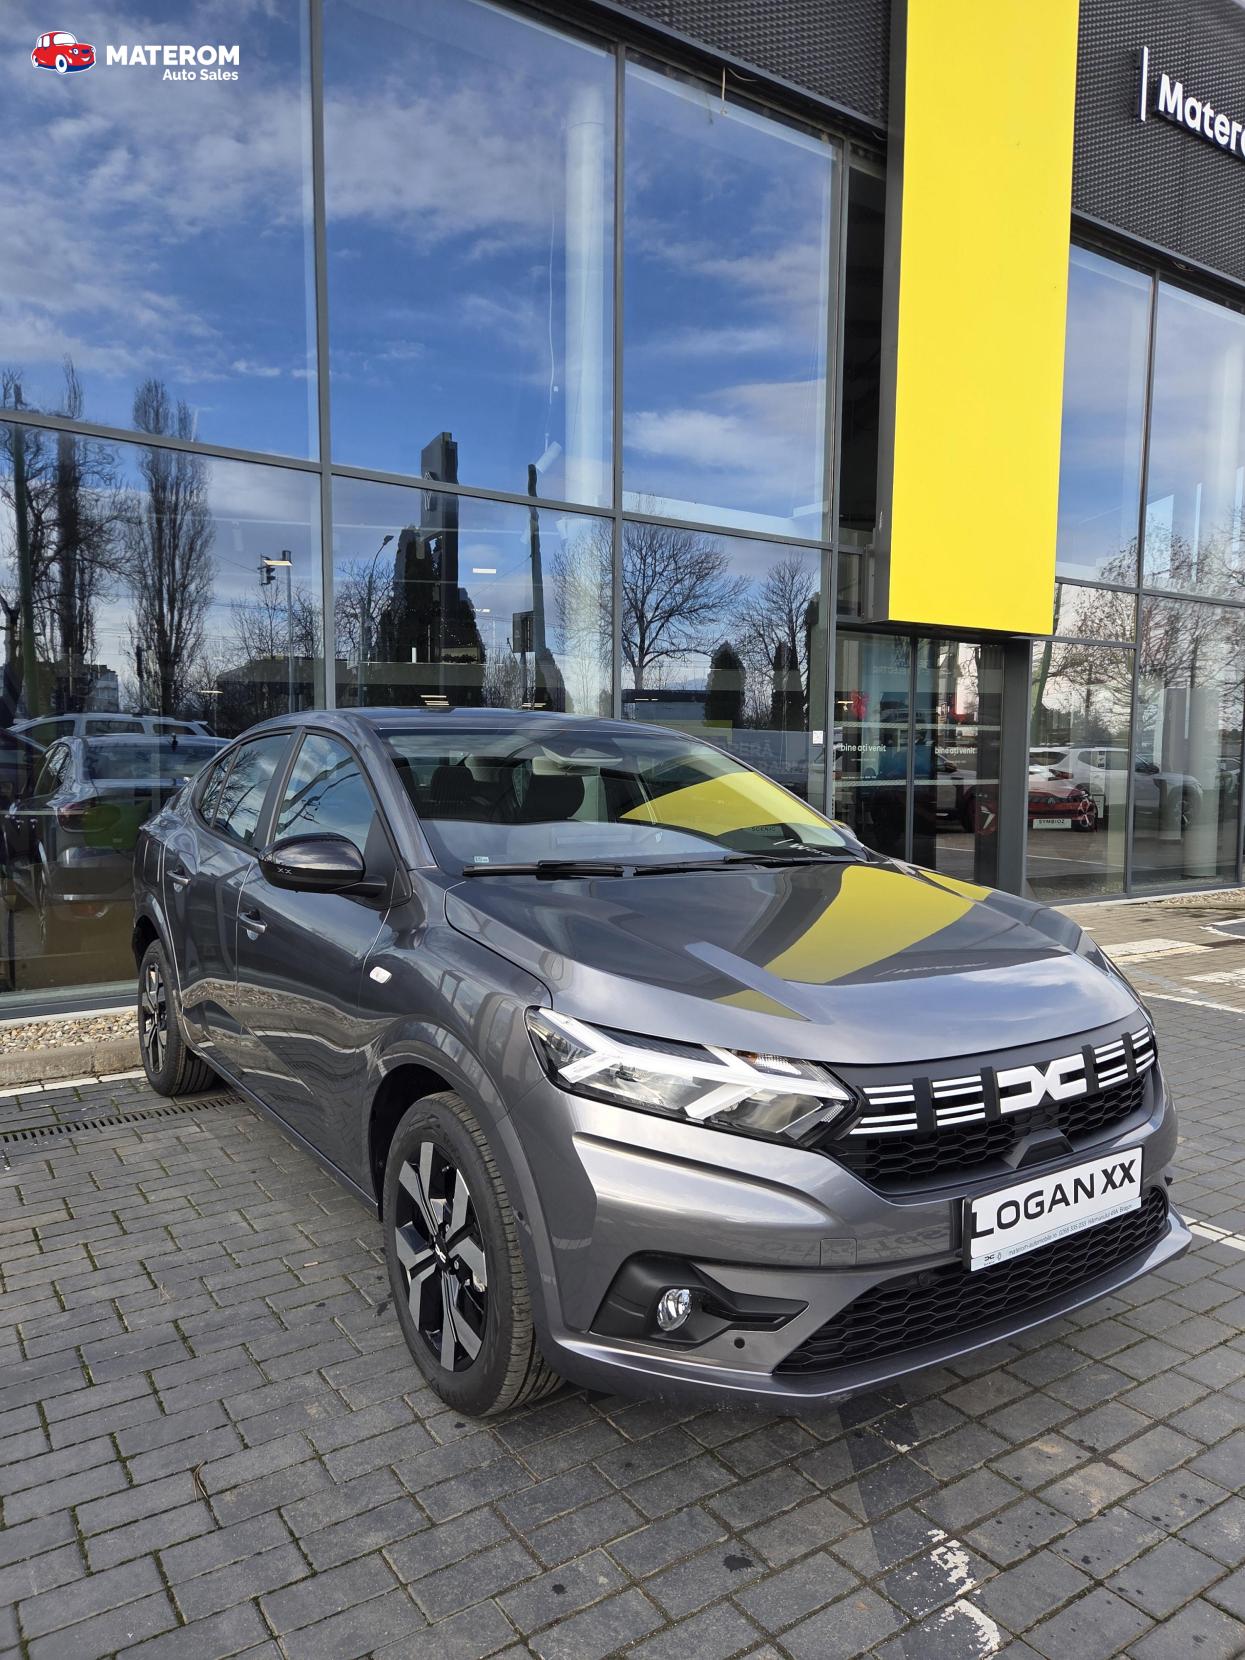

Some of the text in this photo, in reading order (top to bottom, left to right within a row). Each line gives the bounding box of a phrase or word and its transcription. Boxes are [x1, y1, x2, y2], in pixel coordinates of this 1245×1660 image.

[840, 743, 857, 752] bine
[868, 744, 887, 752] venit
[971, 1158, 1136, 1240] LOGAN XX
